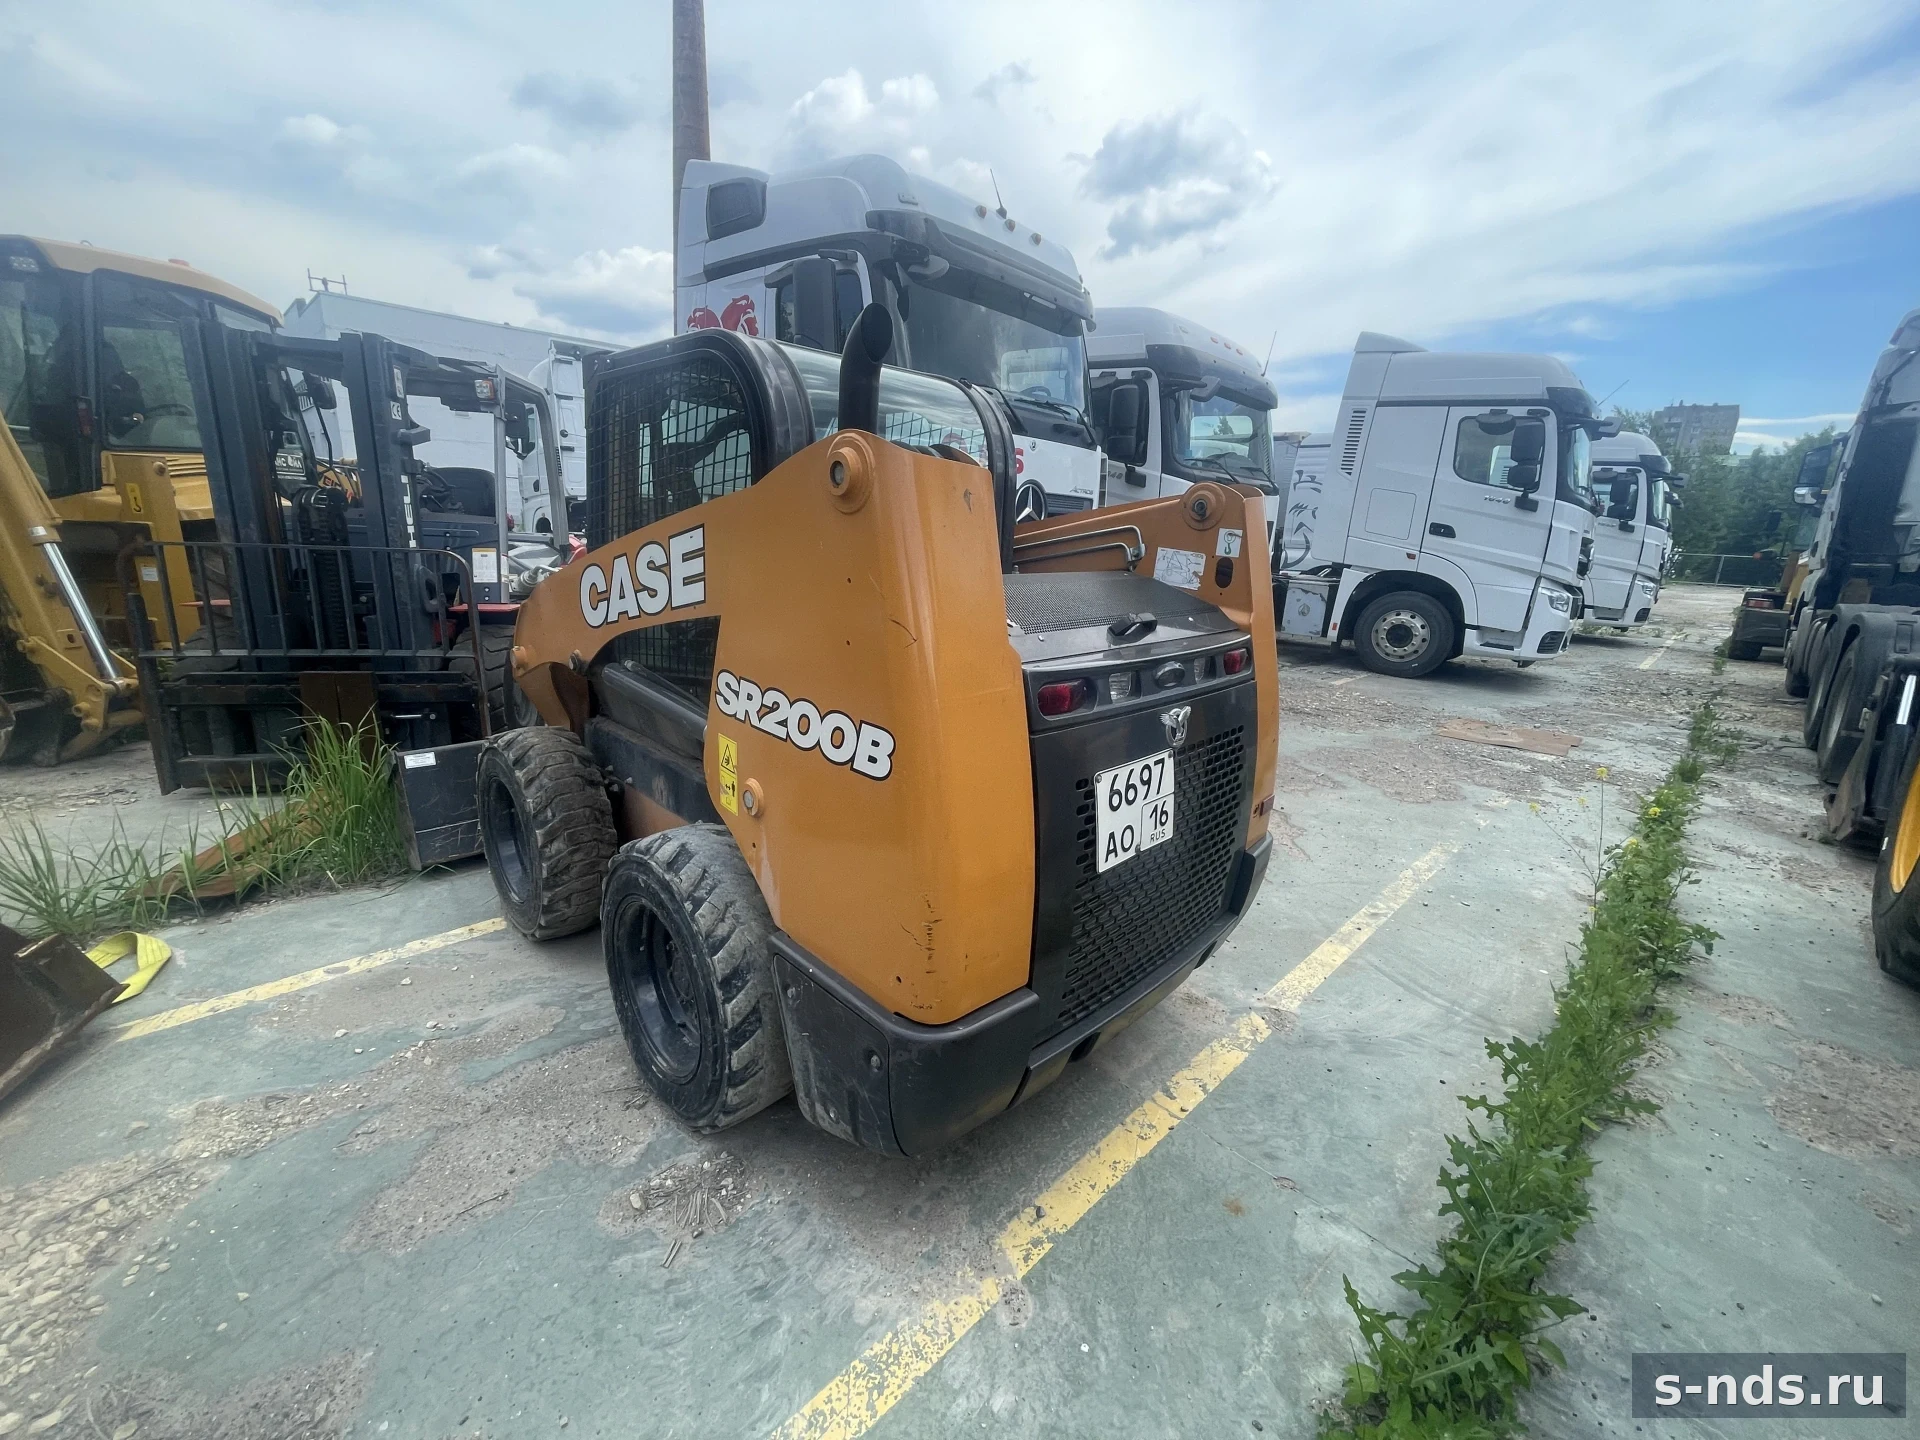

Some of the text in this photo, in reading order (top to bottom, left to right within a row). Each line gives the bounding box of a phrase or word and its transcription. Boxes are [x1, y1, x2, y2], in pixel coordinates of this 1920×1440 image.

[400, 474, 417, 548] HELI
[580, 523, 706, 629] CASE
[715, 669, 896, 781] SR200B
[1108, 757, 1166, 812] 6697
[1149, 800, 1169, 831] 16
[1150, 828, 1166, 844] RUS
